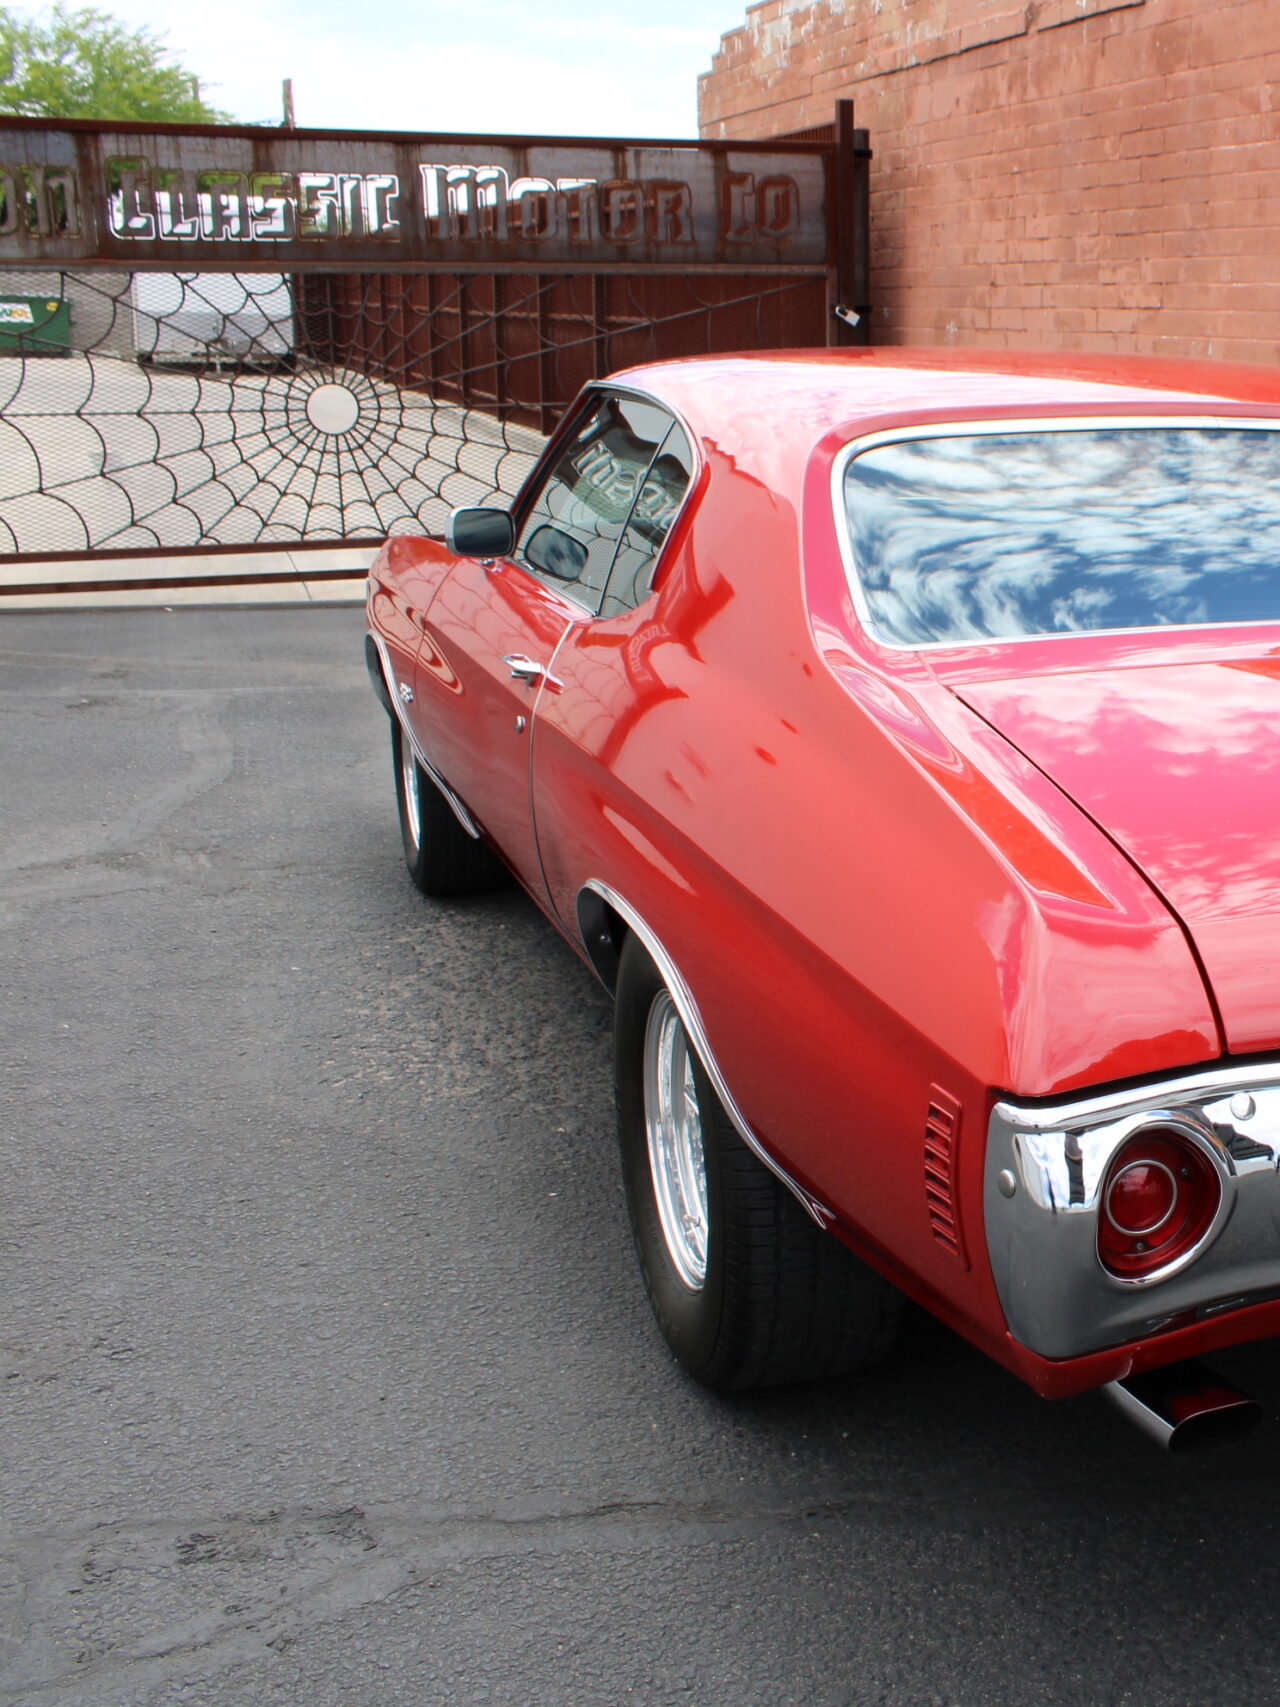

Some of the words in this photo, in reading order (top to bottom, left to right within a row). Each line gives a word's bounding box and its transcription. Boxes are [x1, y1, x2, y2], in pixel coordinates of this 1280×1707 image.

[105, 156, 400, 241] CLASSIC
[419, 163, 697, 247] MOTOR
[719, 171, 800, 248] CO
